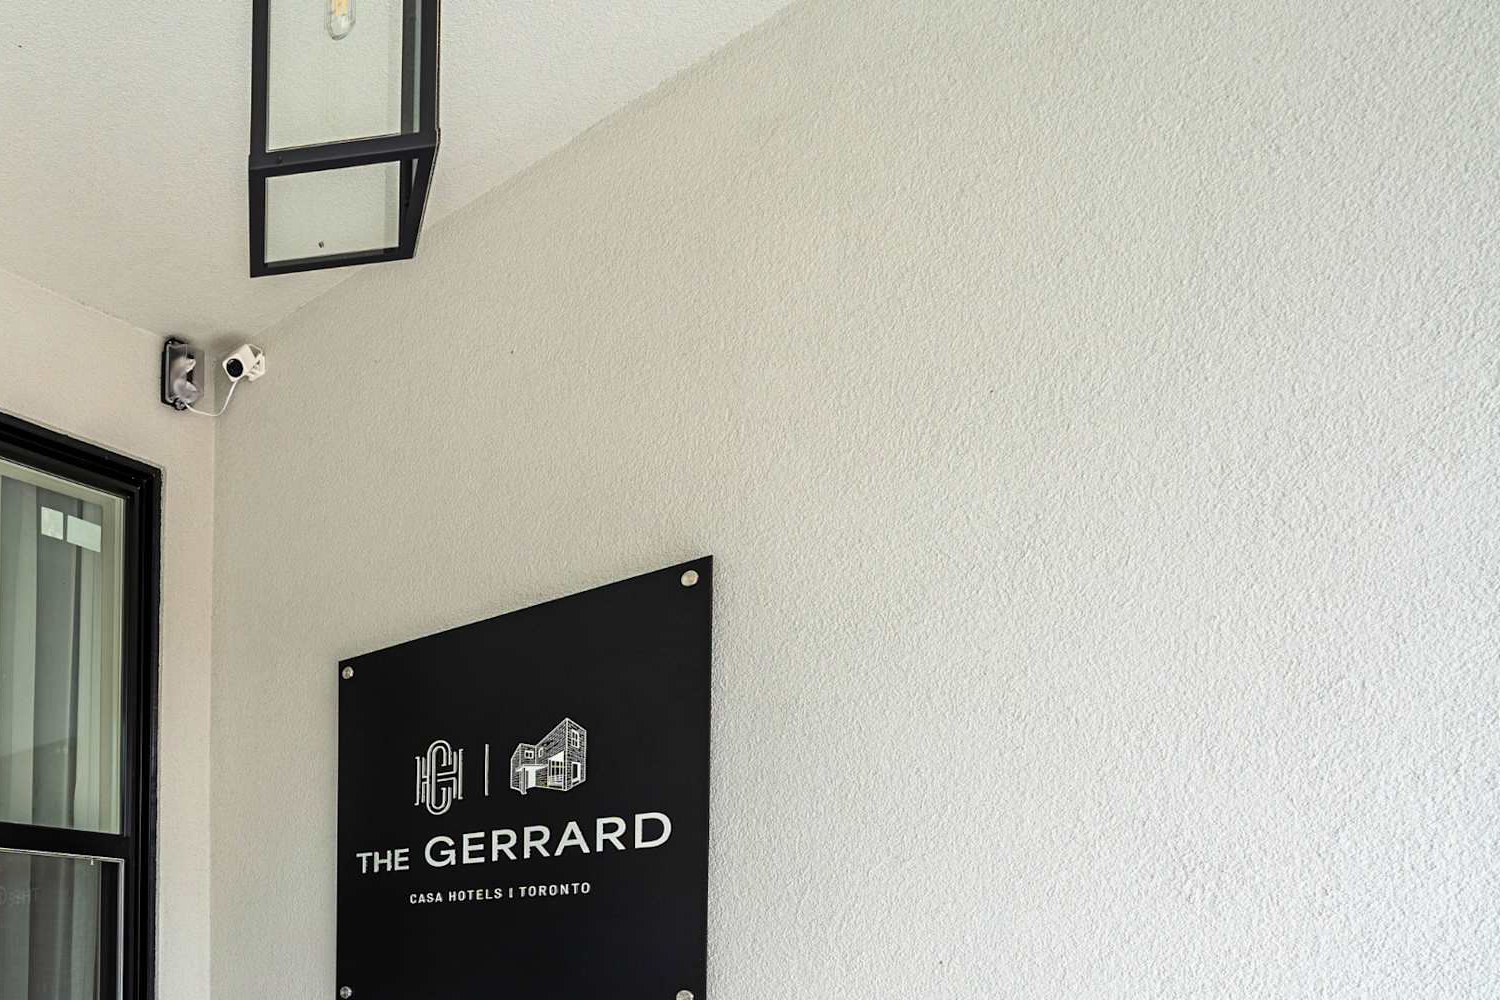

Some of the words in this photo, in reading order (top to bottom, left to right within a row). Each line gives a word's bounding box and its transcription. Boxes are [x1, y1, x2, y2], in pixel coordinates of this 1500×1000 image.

[355, 847, 410, 874] THE
[424, 811, 673, 868] GERRARD
[409, 890, 443, 904] CASA
[448, 887, 503, 902] HOTELS
[518, 881, 591, 898] TORONTO
